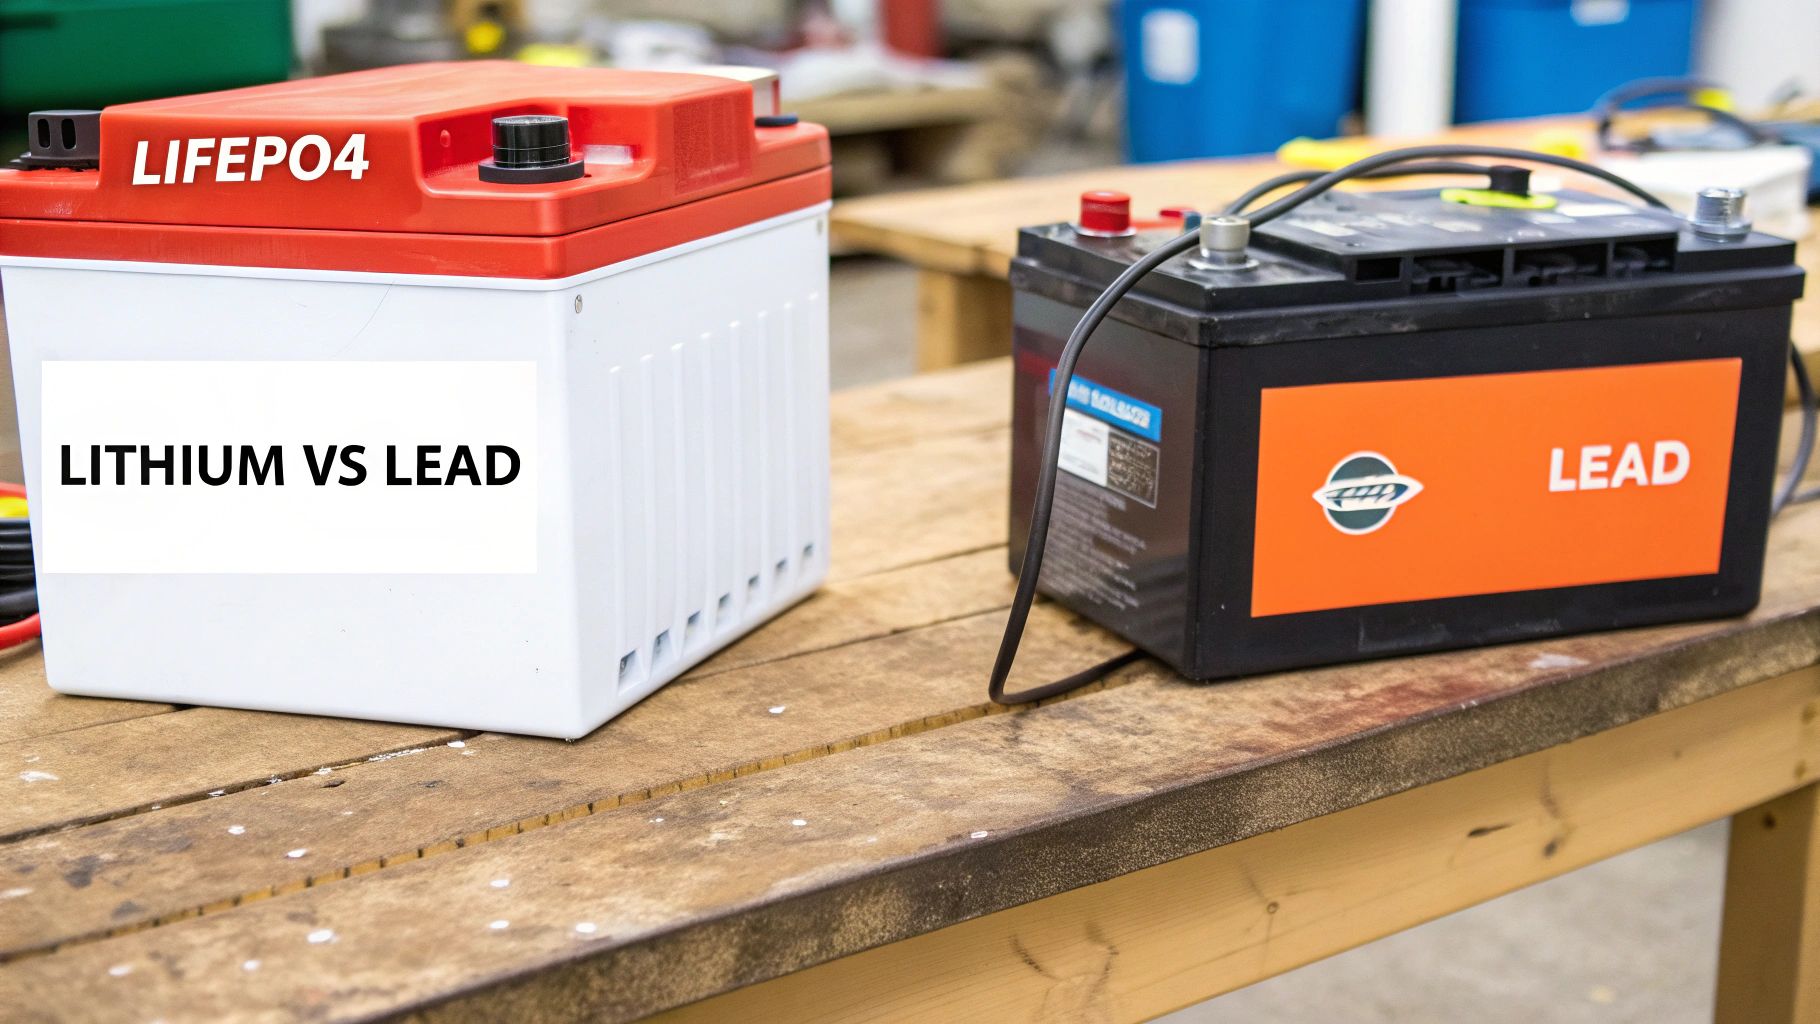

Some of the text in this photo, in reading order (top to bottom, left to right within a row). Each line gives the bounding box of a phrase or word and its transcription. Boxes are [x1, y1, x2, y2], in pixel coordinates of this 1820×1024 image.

[132, 133, 370, 186] LIFEPO4
[61, 444, 521, 487] LITHIUM VS LEAD
[1548, 440, 1691, 492] LEAD
